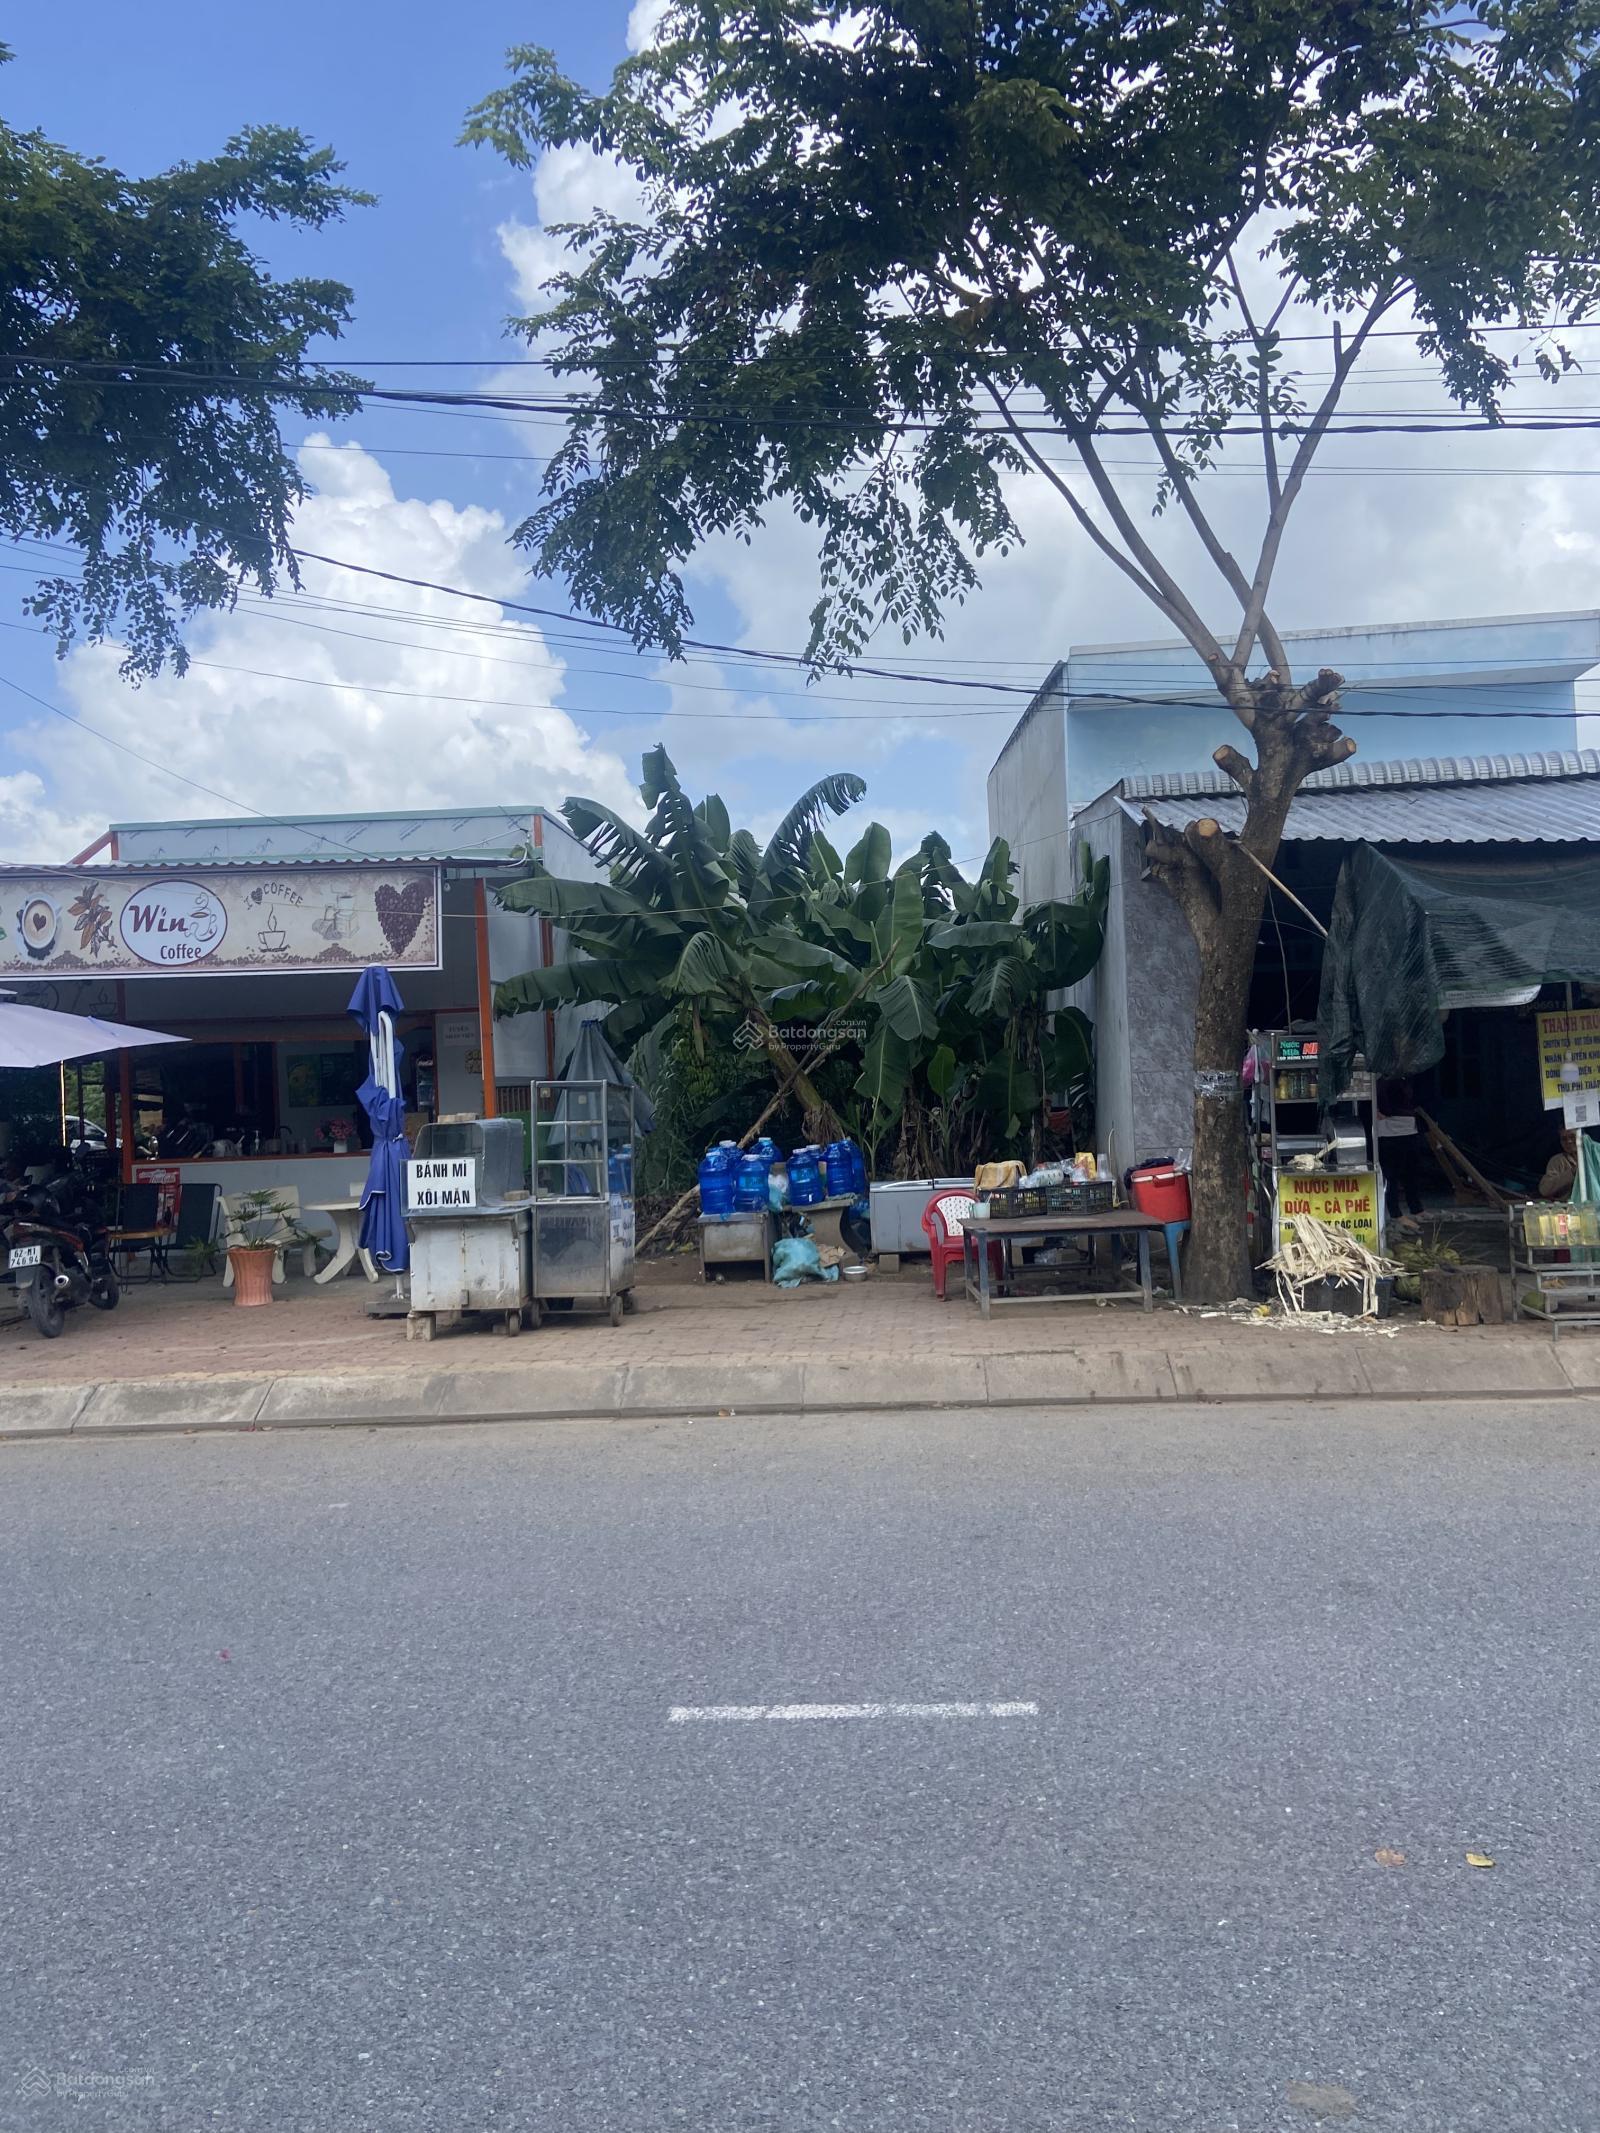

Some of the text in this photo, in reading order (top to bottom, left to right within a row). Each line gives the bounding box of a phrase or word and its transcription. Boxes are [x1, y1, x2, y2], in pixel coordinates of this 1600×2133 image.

[263, 881, 303, 908] COFFEE
[128, 904, 189, 933] Win
[160, 943, 202, 960] Coffee
[416, 1160, 467, 1178] BÁNH MÌ
[1294, 1178, 1329, 1194] NƯỚC
[417, 1188, 470, 1207] XÔI MẶN
[1324, 1197, 1342, 1214] CÀ
[1345, 1196, 1371, 1213] PHÊ
[1353, 1218, 1372, 1231] LOẠI
